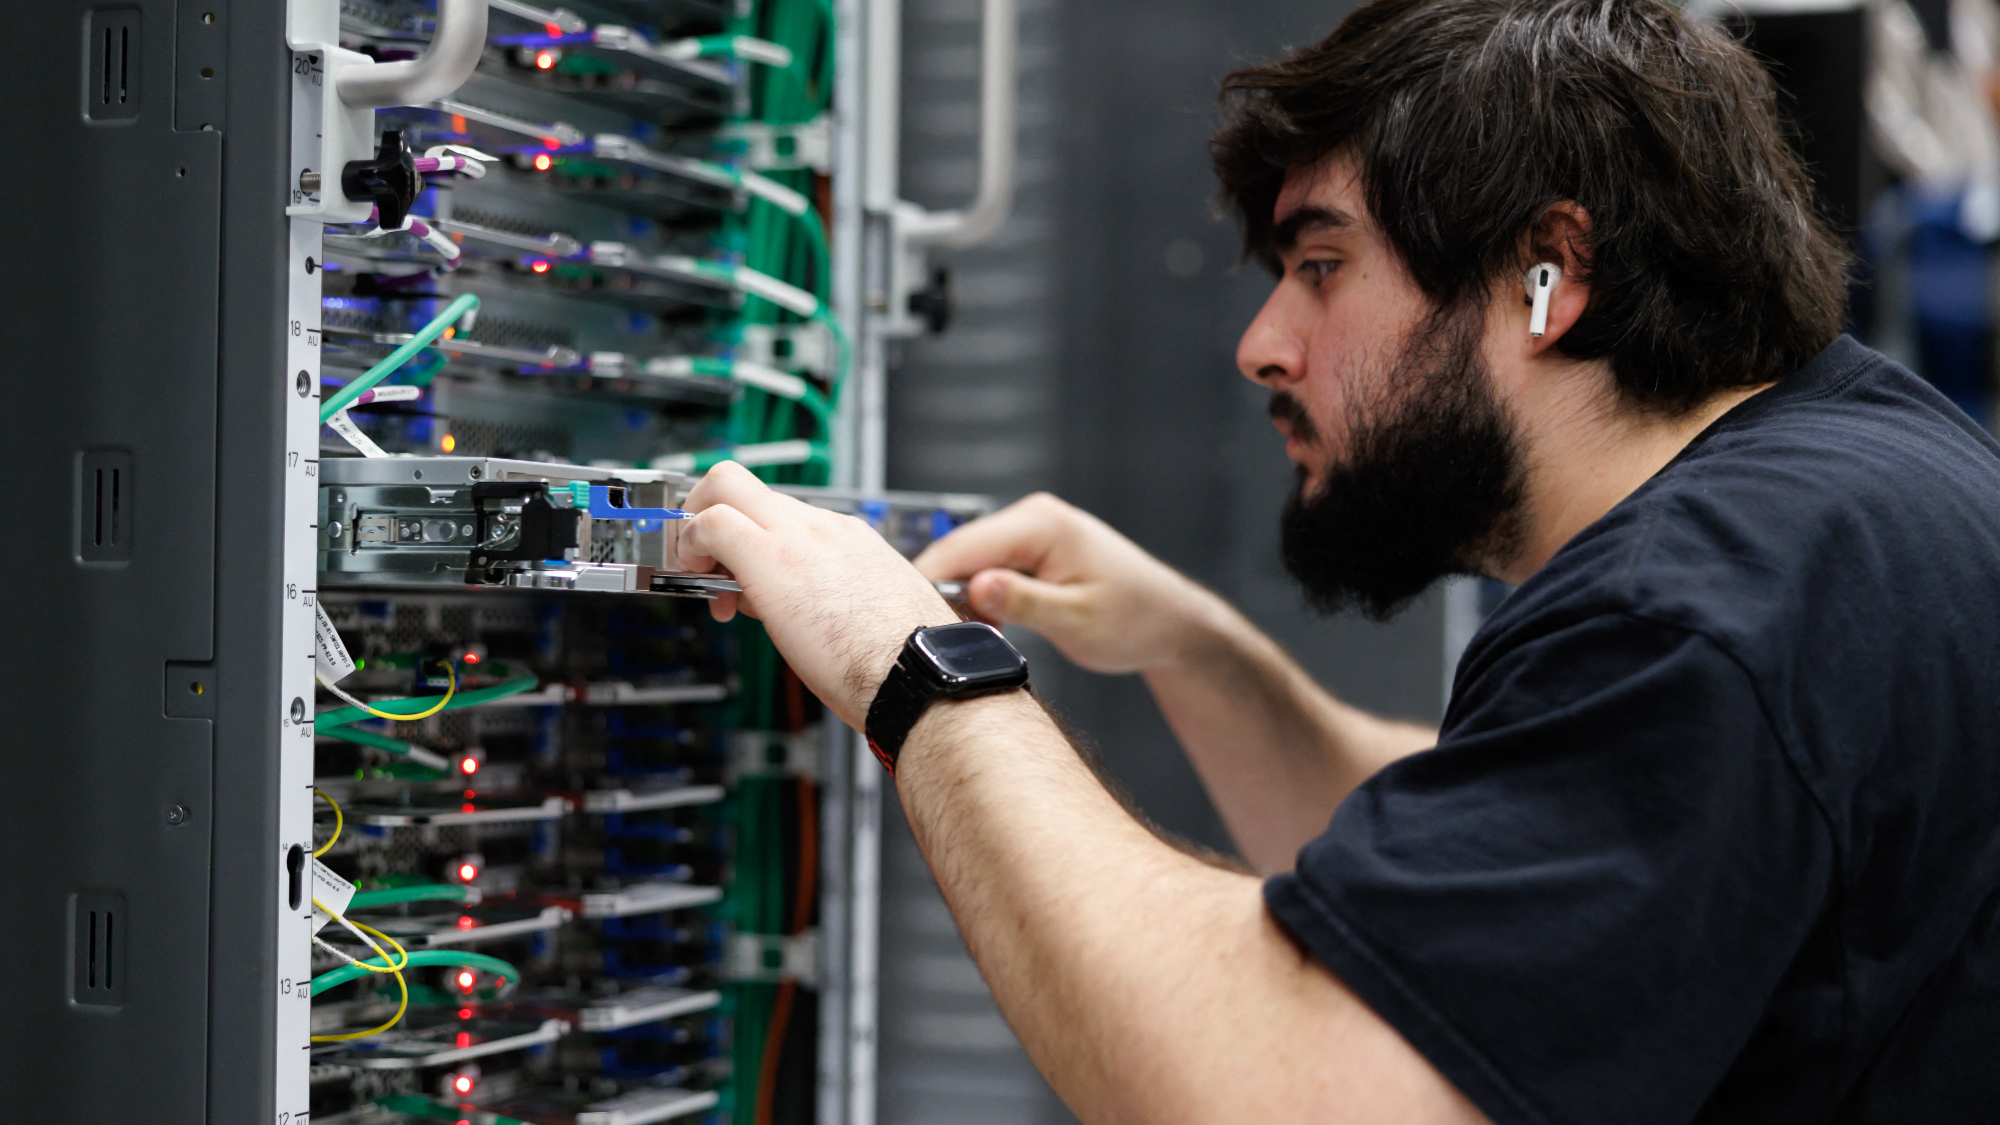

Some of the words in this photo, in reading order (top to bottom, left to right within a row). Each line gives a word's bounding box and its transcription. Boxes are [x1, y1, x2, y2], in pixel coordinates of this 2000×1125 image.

[294, 57, 310, 75] 20
[311, 74, 323, 87] AU
[292, 189, 302, 204] 19
[290, 320, 301, 336] 18
[307, 336, 318, 347] AU
[287, 452, 298, 468] 17
[305, 466, 316, 477] AU
[286, 584, 297, 600] 16
[303, 597, 314, 608] AU
[283, 718, 290, 727] 15
[301, 727, 312, 738] AU
[282, 843, 289, 852] 14
[303, 841, 312, 849] AU
[280, 978, 291, 995] 13
[297, 988, 308, 999] AU
[278, 1112, 290, 1125] 12
